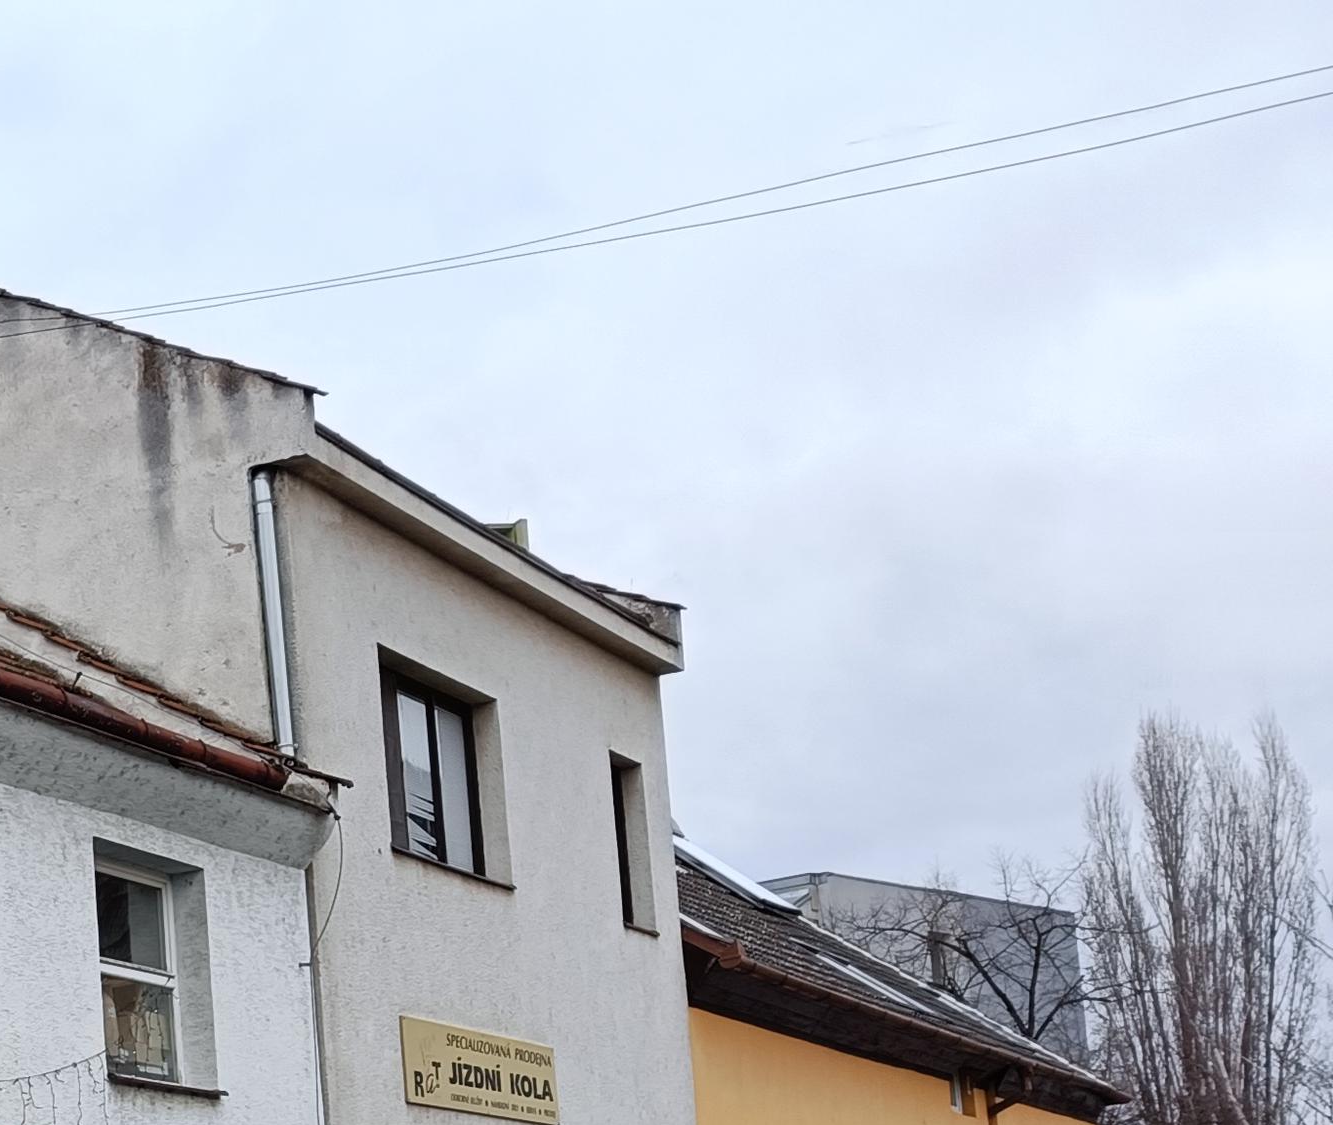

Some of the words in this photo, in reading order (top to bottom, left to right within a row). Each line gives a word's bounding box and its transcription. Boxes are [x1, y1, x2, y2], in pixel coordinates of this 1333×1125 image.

[445, 1032, 511, 1060] SPECIALIZOVANÁ
[514, 1047, 552, 1068] PRODEJNA
[448, 1056, 502, 1093] JÍZDNÍ
[509, 1072, 554, 1102] KOLA
